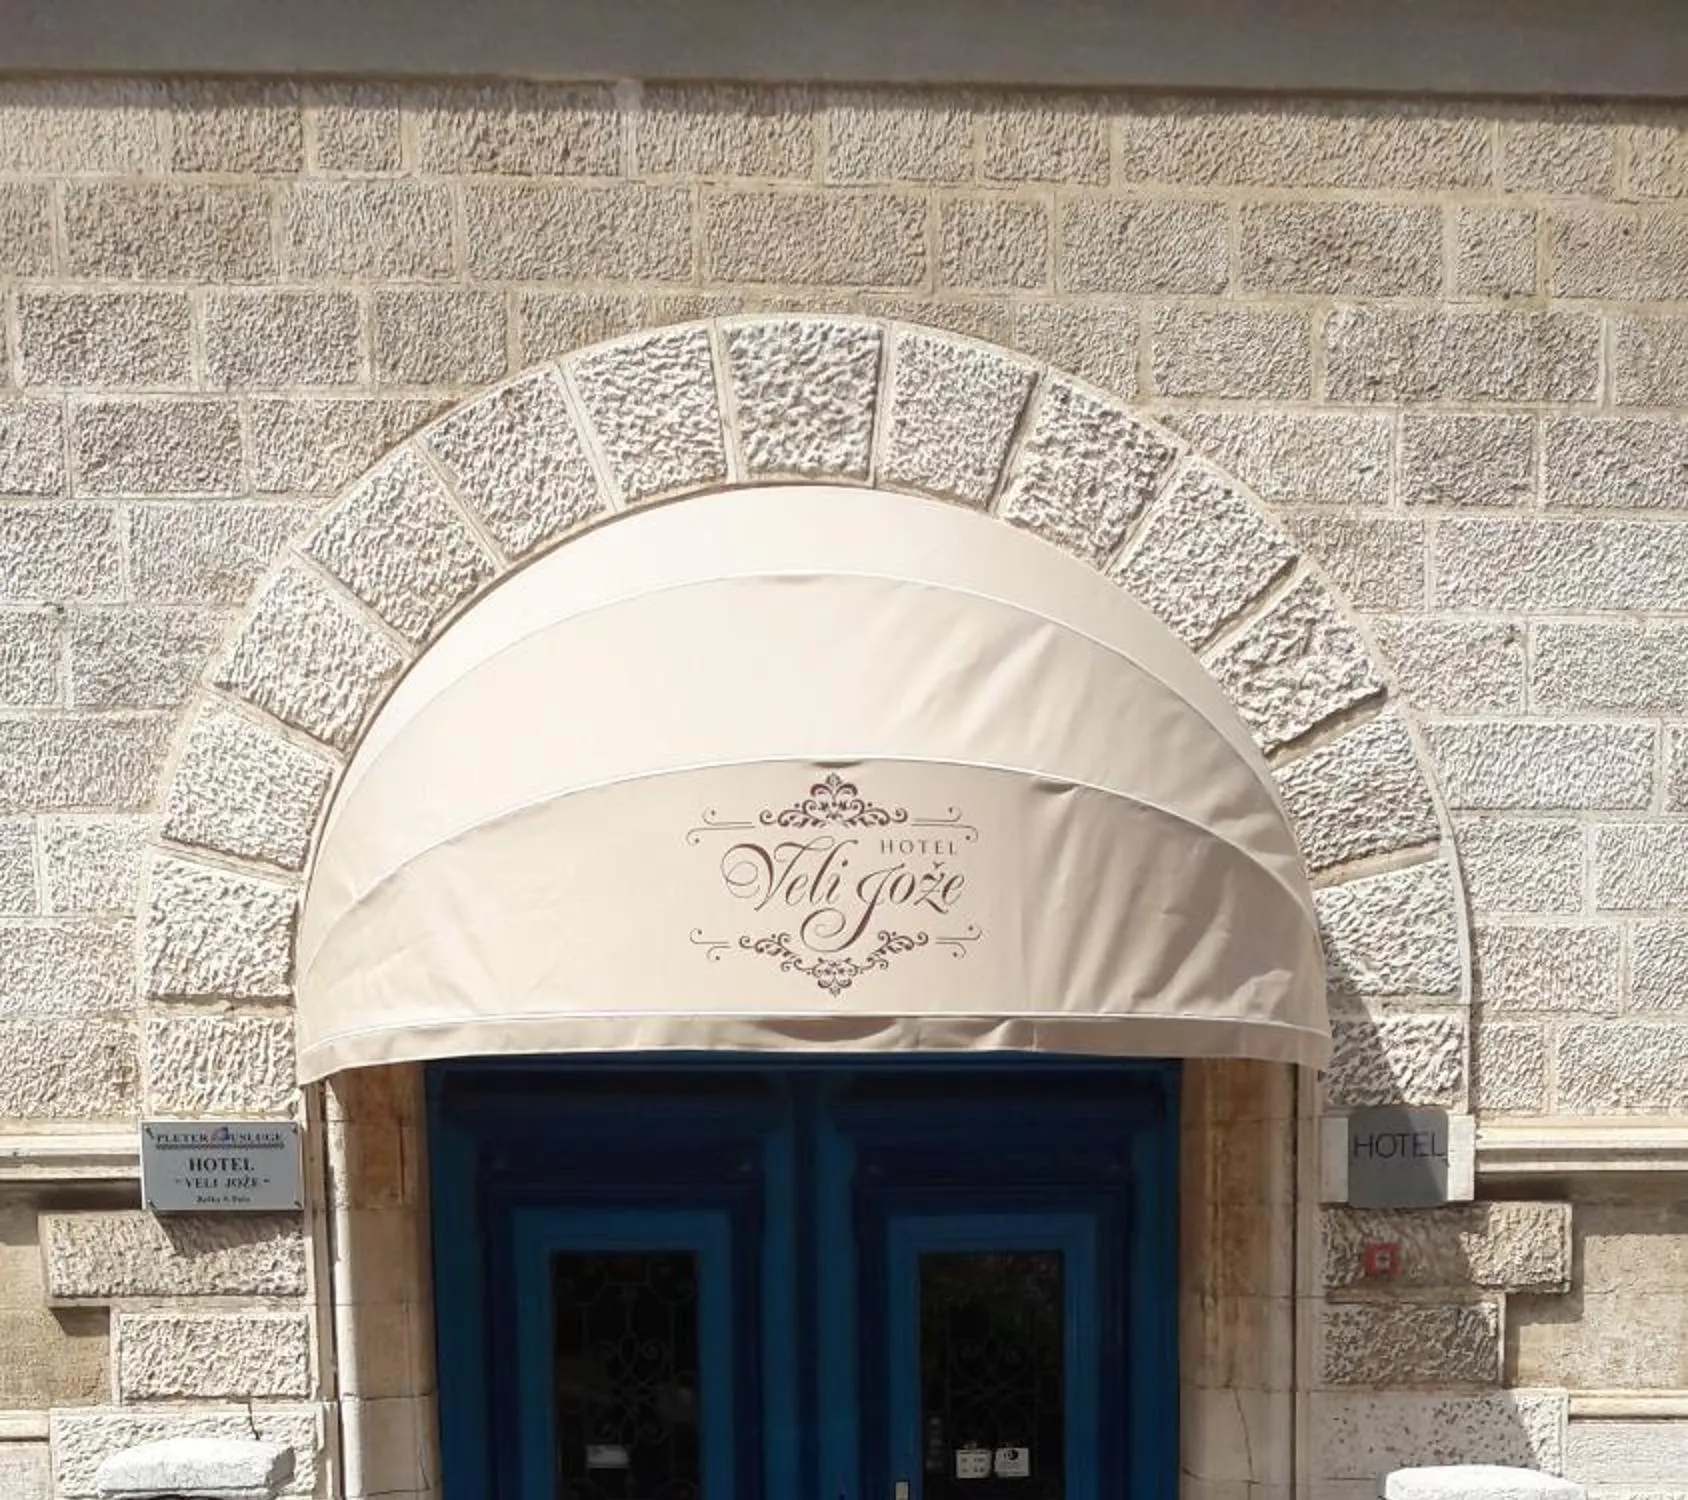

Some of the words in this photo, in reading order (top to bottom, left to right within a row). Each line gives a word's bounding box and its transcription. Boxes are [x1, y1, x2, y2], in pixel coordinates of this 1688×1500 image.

[880, 839, 957, 856] HOTEL
[720, 835, 859, 912] Veli
[800, 861, 965, 952] Jože
[1353, 1132, 1447, 1159] HOTEL
[188, 1156, 255, 1172] HOTEL
